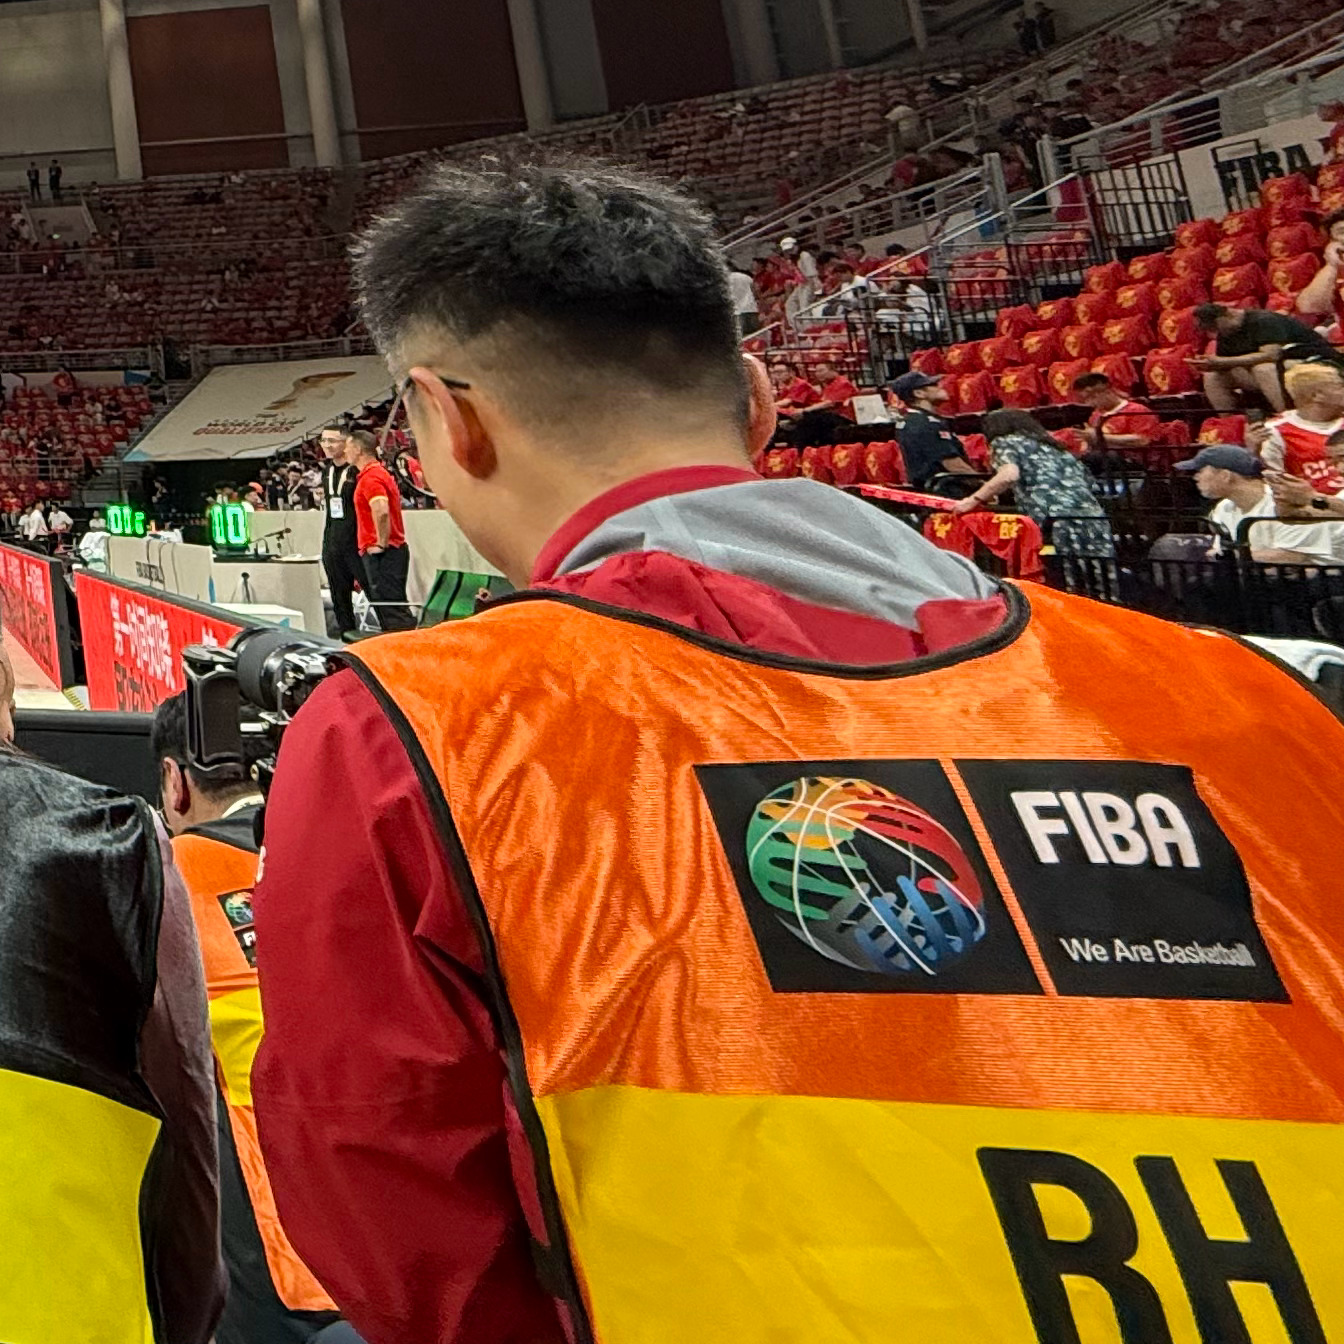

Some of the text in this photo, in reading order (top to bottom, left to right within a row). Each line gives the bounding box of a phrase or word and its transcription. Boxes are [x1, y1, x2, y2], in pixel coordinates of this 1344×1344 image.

[1010, 790, 1200, 869] FIBA
[1061, 936, 1255, 969] We Are Basketball
[976, 1146, 1326, 1344] RH
